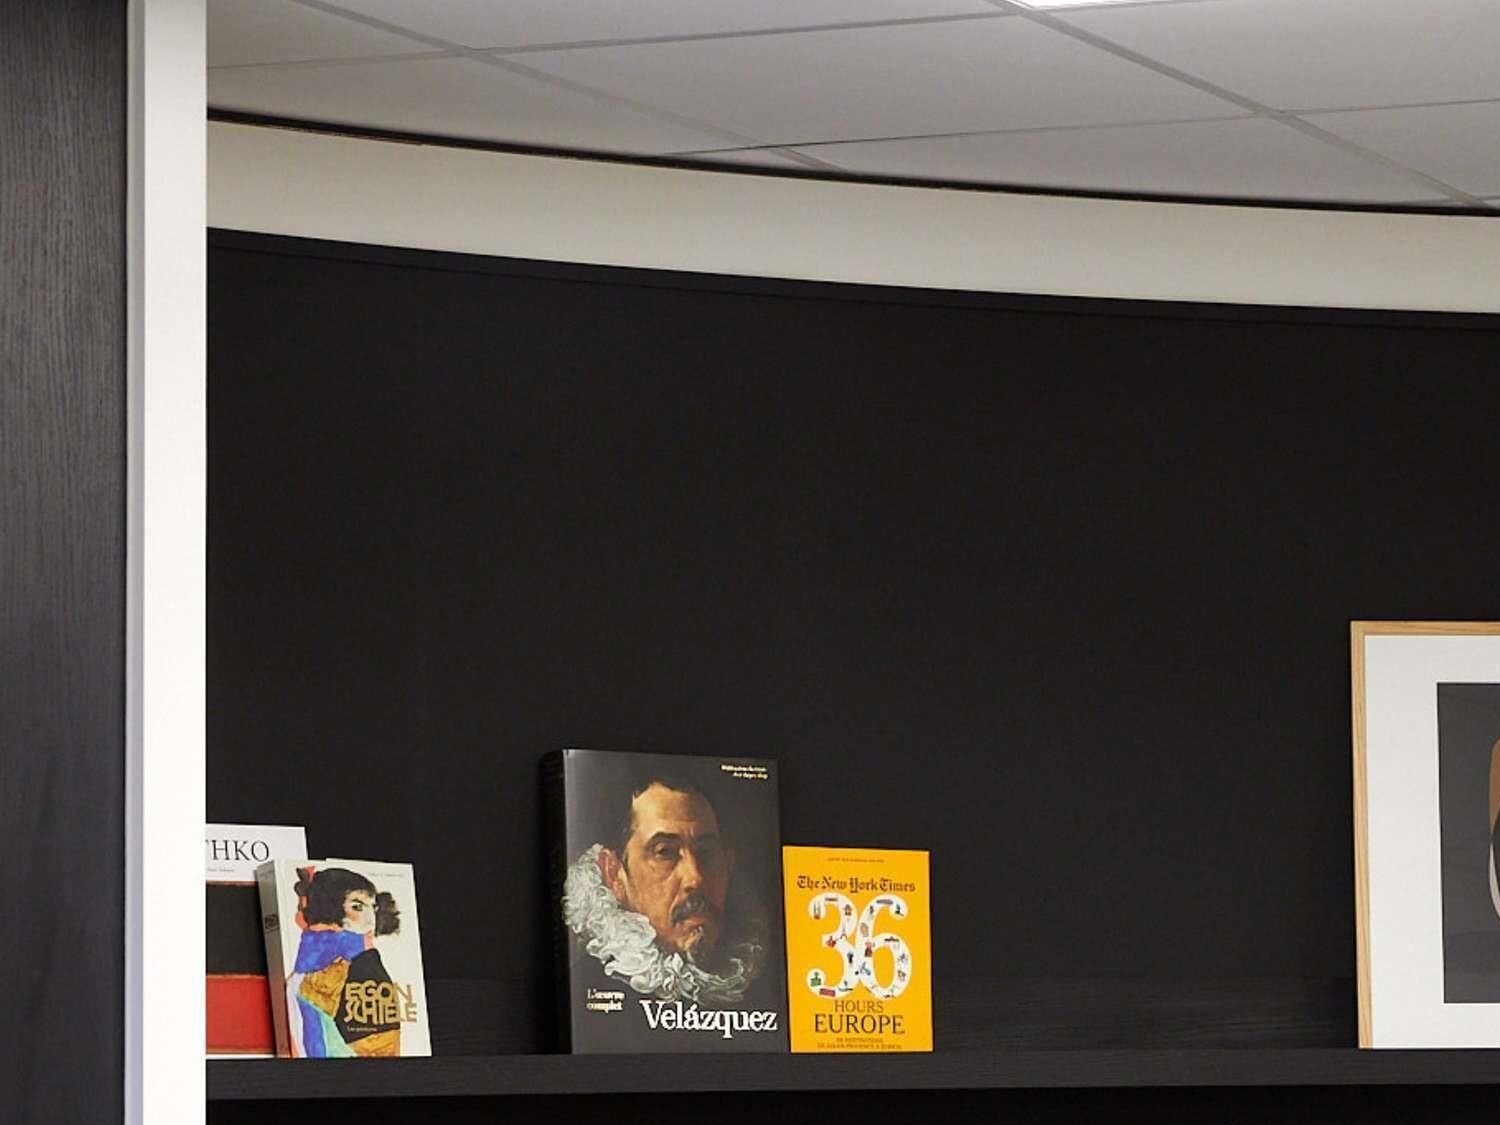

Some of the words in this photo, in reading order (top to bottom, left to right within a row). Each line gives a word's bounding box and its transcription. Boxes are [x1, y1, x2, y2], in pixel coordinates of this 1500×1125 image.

[206, 839, 269, 862] HKO
[797, 875, 820, 890] The
[820, 876, 847, 890] New
[849, 877, 878, 894] York
[879, 878, 916, 893] Times
[807, 892, 912, 1001] 36
[345, 980, 414, 1006] EGON
[343, 1000, 417, 1025] SCHIELE
[834, 999, 884, 1013] HOURS
[639, 1000, 778, 1038] Velázquez
[815, 1014, 905, 1034] EUROPE
